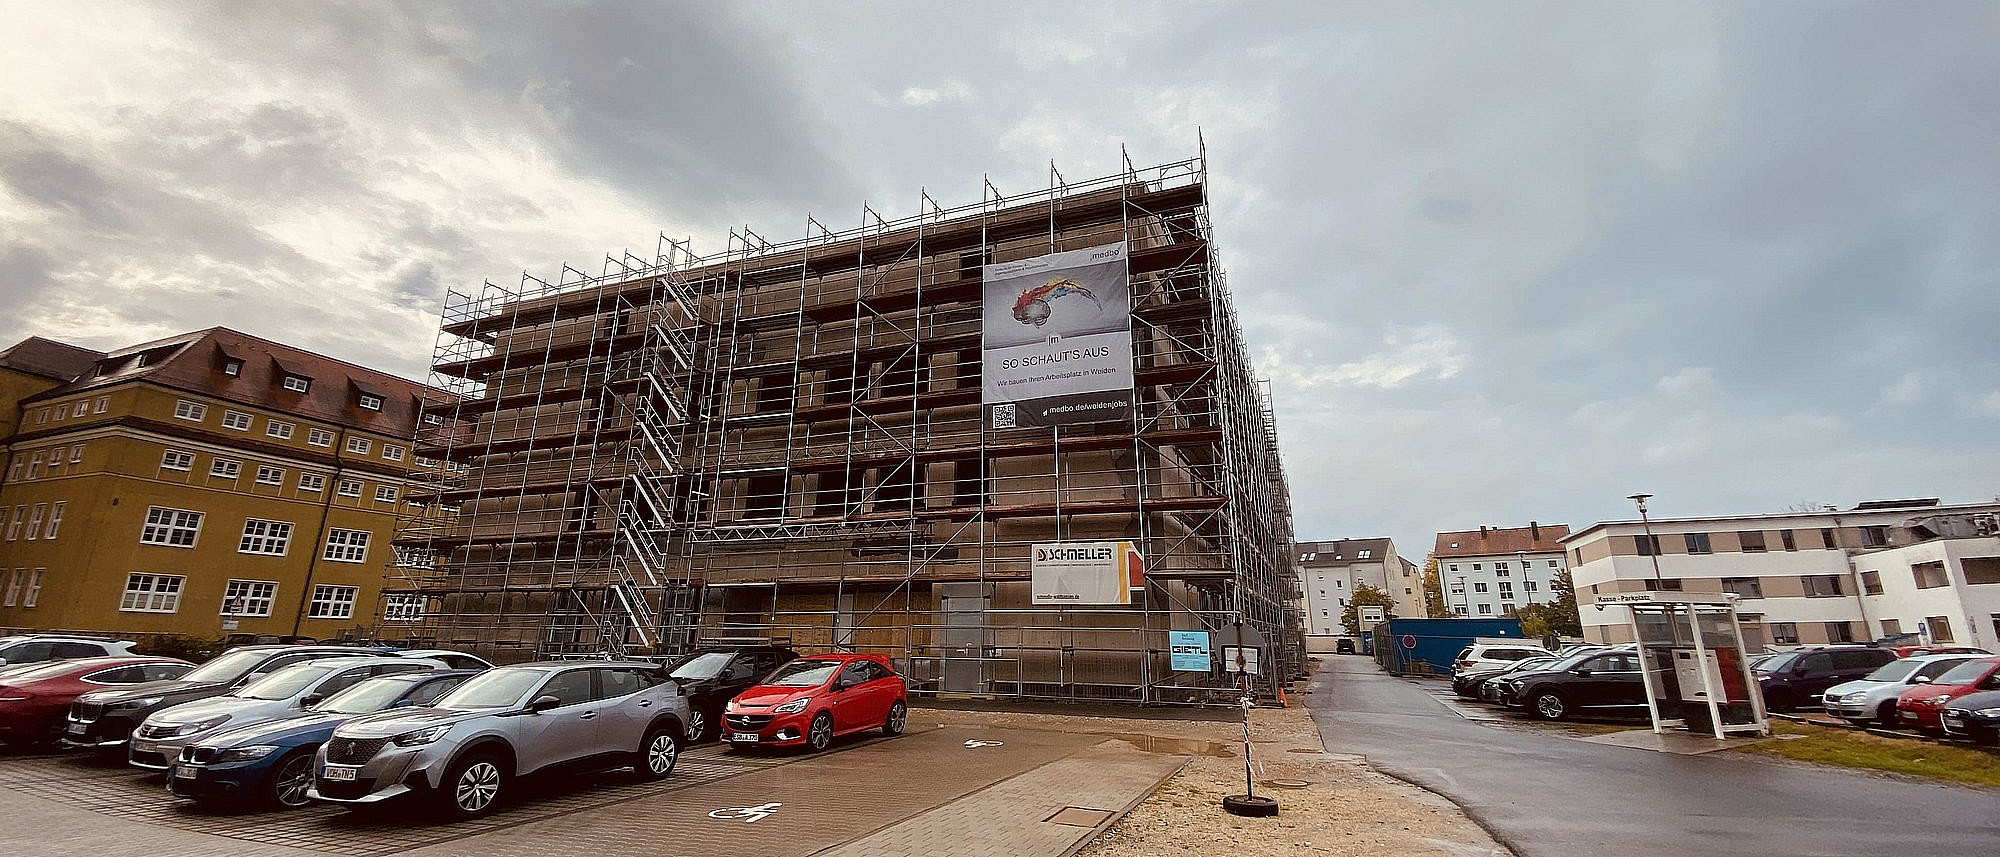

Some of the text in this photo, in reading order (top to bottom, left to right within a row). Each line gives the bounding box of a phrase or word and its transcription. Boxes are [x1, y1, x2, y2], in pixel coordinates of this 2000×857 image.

[1002, 346, 1109, 369] SO SCHAUT'S AUS
[1008, 377, 1028, 386] bauen
[1029, 375, 1045, 383] Ihren
[1045, 370, 1082, 381] Arbeitsplatz
[1090, 367, 1116, 375] Weiden
[1049, 400, 1128, 414] medbo.de/weidenjobs
[1049, 548, 1112, 560] SCHMELLER
[1171, 645, 1208, 655] GIETL
